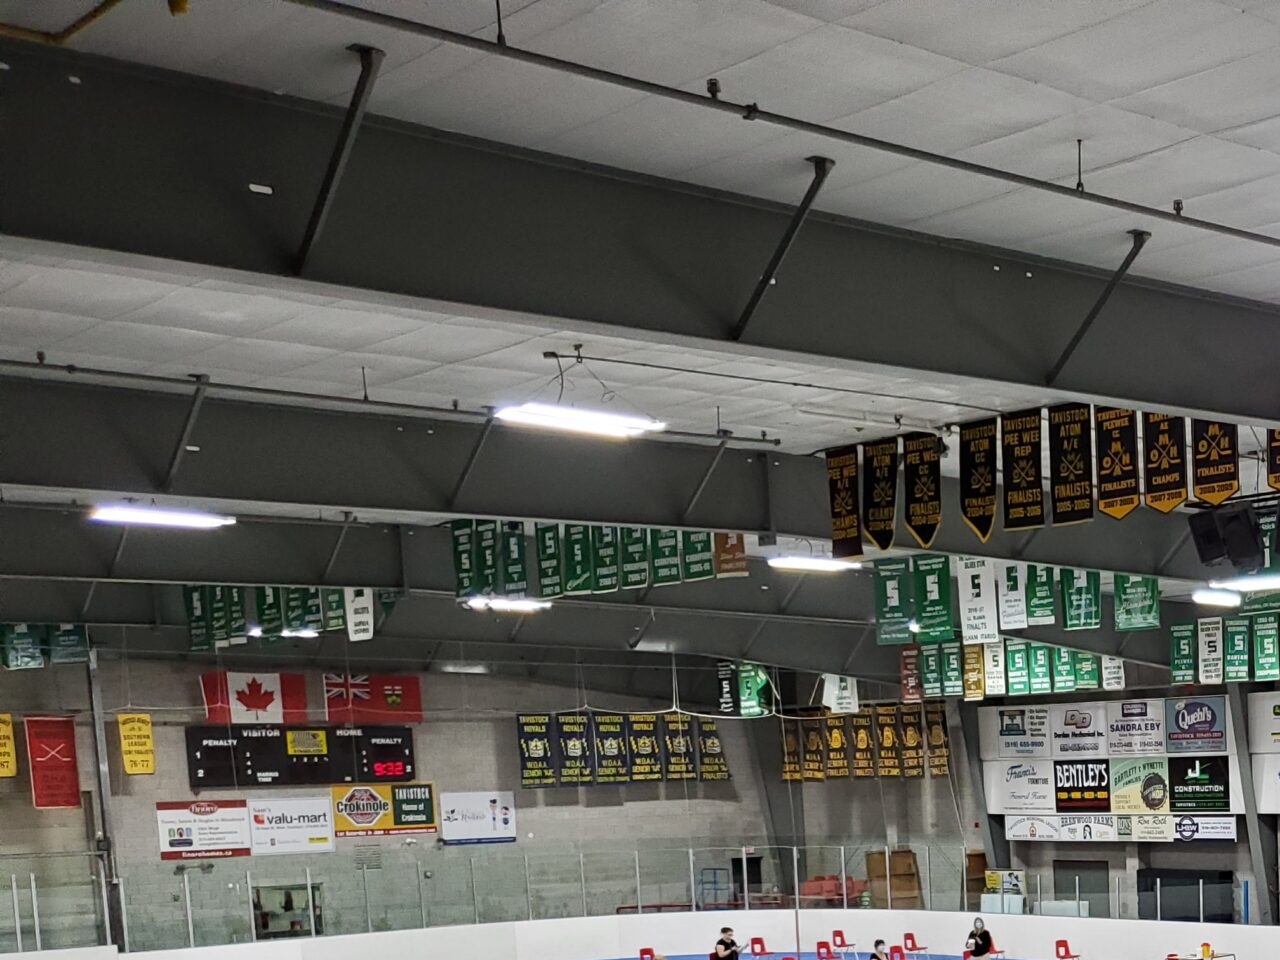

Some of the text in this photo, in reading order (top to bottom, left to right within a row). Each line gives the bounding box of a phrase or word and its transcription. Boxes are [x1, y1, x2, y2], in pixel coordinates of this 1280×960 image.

[1060, 424, 1081, 436] ATOM
[1015, 446, 1031, 456] REP
[1179, 707, 1212, 730] Quehl's
[1110, 722, 1160, 732] SANDRA EBY
[1056, 764, 1108, 787] BENTLEY'S
[395, 788, 430, 799] TAVISTOCK
[336, 800, 389, 813] Crokinole
[266, 812, 328, 825] valu-mart
